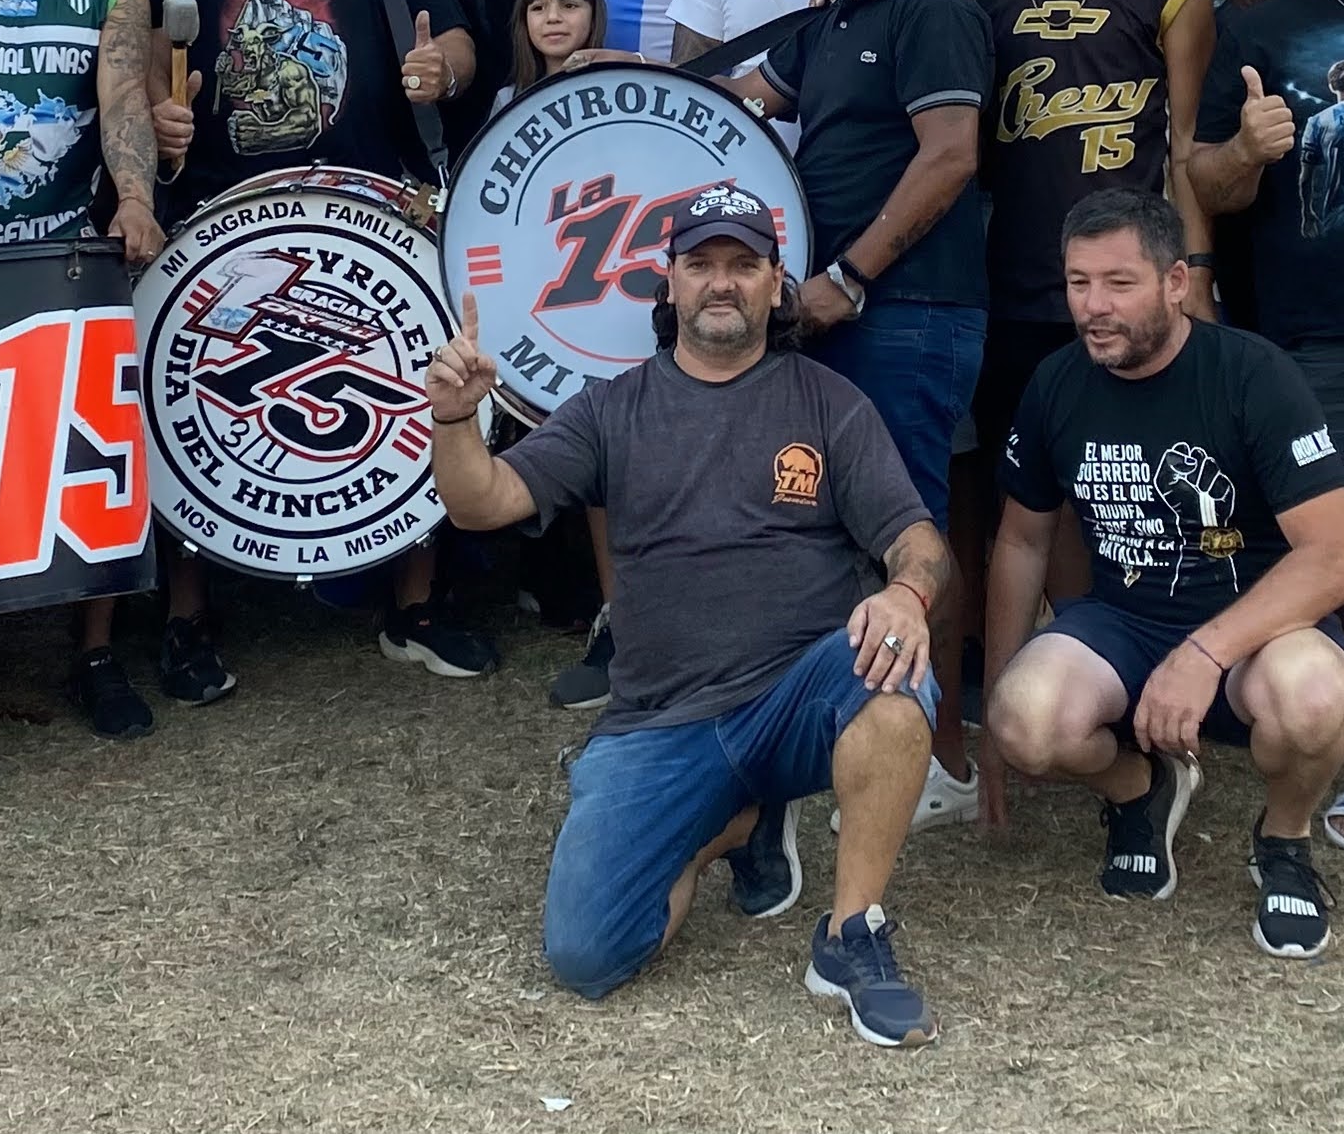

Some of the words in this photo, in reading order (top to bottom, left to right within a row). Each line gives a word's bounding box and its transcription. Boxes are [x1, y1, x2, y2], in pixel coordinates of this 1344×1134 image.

[997, 57, 1159, 143] Chevy
[479, 81, 747, 216] CHEVROLET
[1081, 121, 1137, 174] 15
[545, 172, 617, 227] La
[160, 248, 190, 279] MI
[194, 200, 307, 248] SAGRADA
[324, 202, 420, 260] FAMILIA.
[287, 285, 377, 322] GRACIAS
[165, 333, 198, 407] DIA
[172, 415, 225, 488] DEL
[1077, 462, 1151, 483] GUERRERO
[1085, 441, 1098, 462] EL
[1101, 444, 1143, 463] MEJOR
[231, 465, 399, 518] HINCHA
[780, 470, 816, 494] TM
[1074, 483, 1090, 500] NO
[1093, 483, 1108, 502] ES
[1112, 484, 1128, 502] EL
[1130, 484, 1155, 502] QUE
[173, 497, 220, 538] NOS
[232, 534, 281, 562] UNE
[297, 545, 330, 565] LA
[344, 511, 422, 557] MISMA
[1090, 503, 1145, 520] TRIUNFA
[1133, 517, 1165, 536] SINO
[1266, 894, 1320, 918] PUMA
